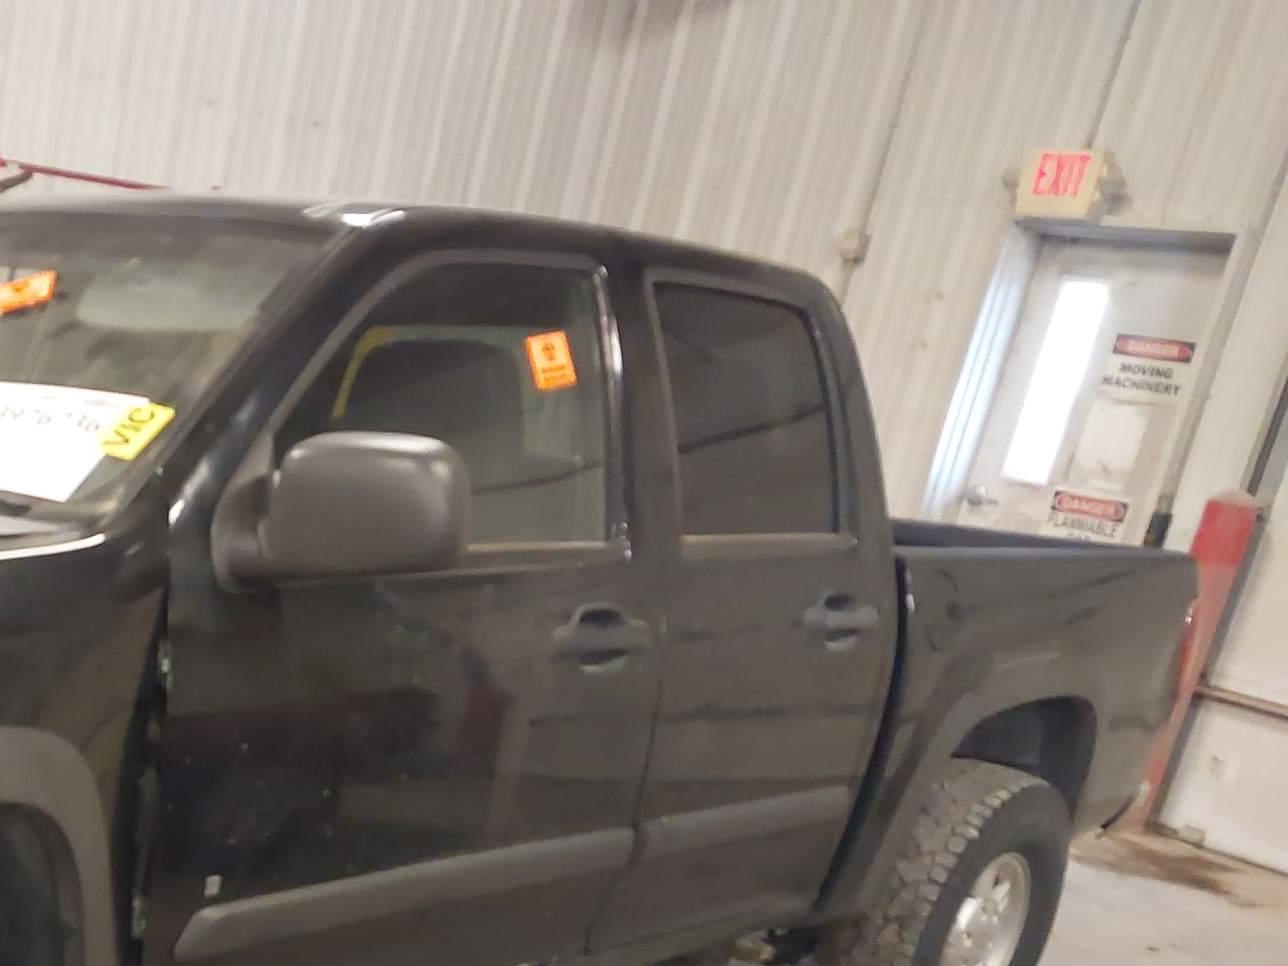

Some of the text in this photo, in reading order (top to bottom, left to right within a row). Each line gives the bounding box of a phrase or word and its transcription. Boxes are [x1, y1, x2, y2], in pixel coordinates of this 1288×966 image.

[1032, 153, 1091, 196] EXIT
[1119, 362, 1174, 379] MOVING
[1102, 375, 1181, 396] MACHINERY
[1063, 494, 1116, 516] DANGER
